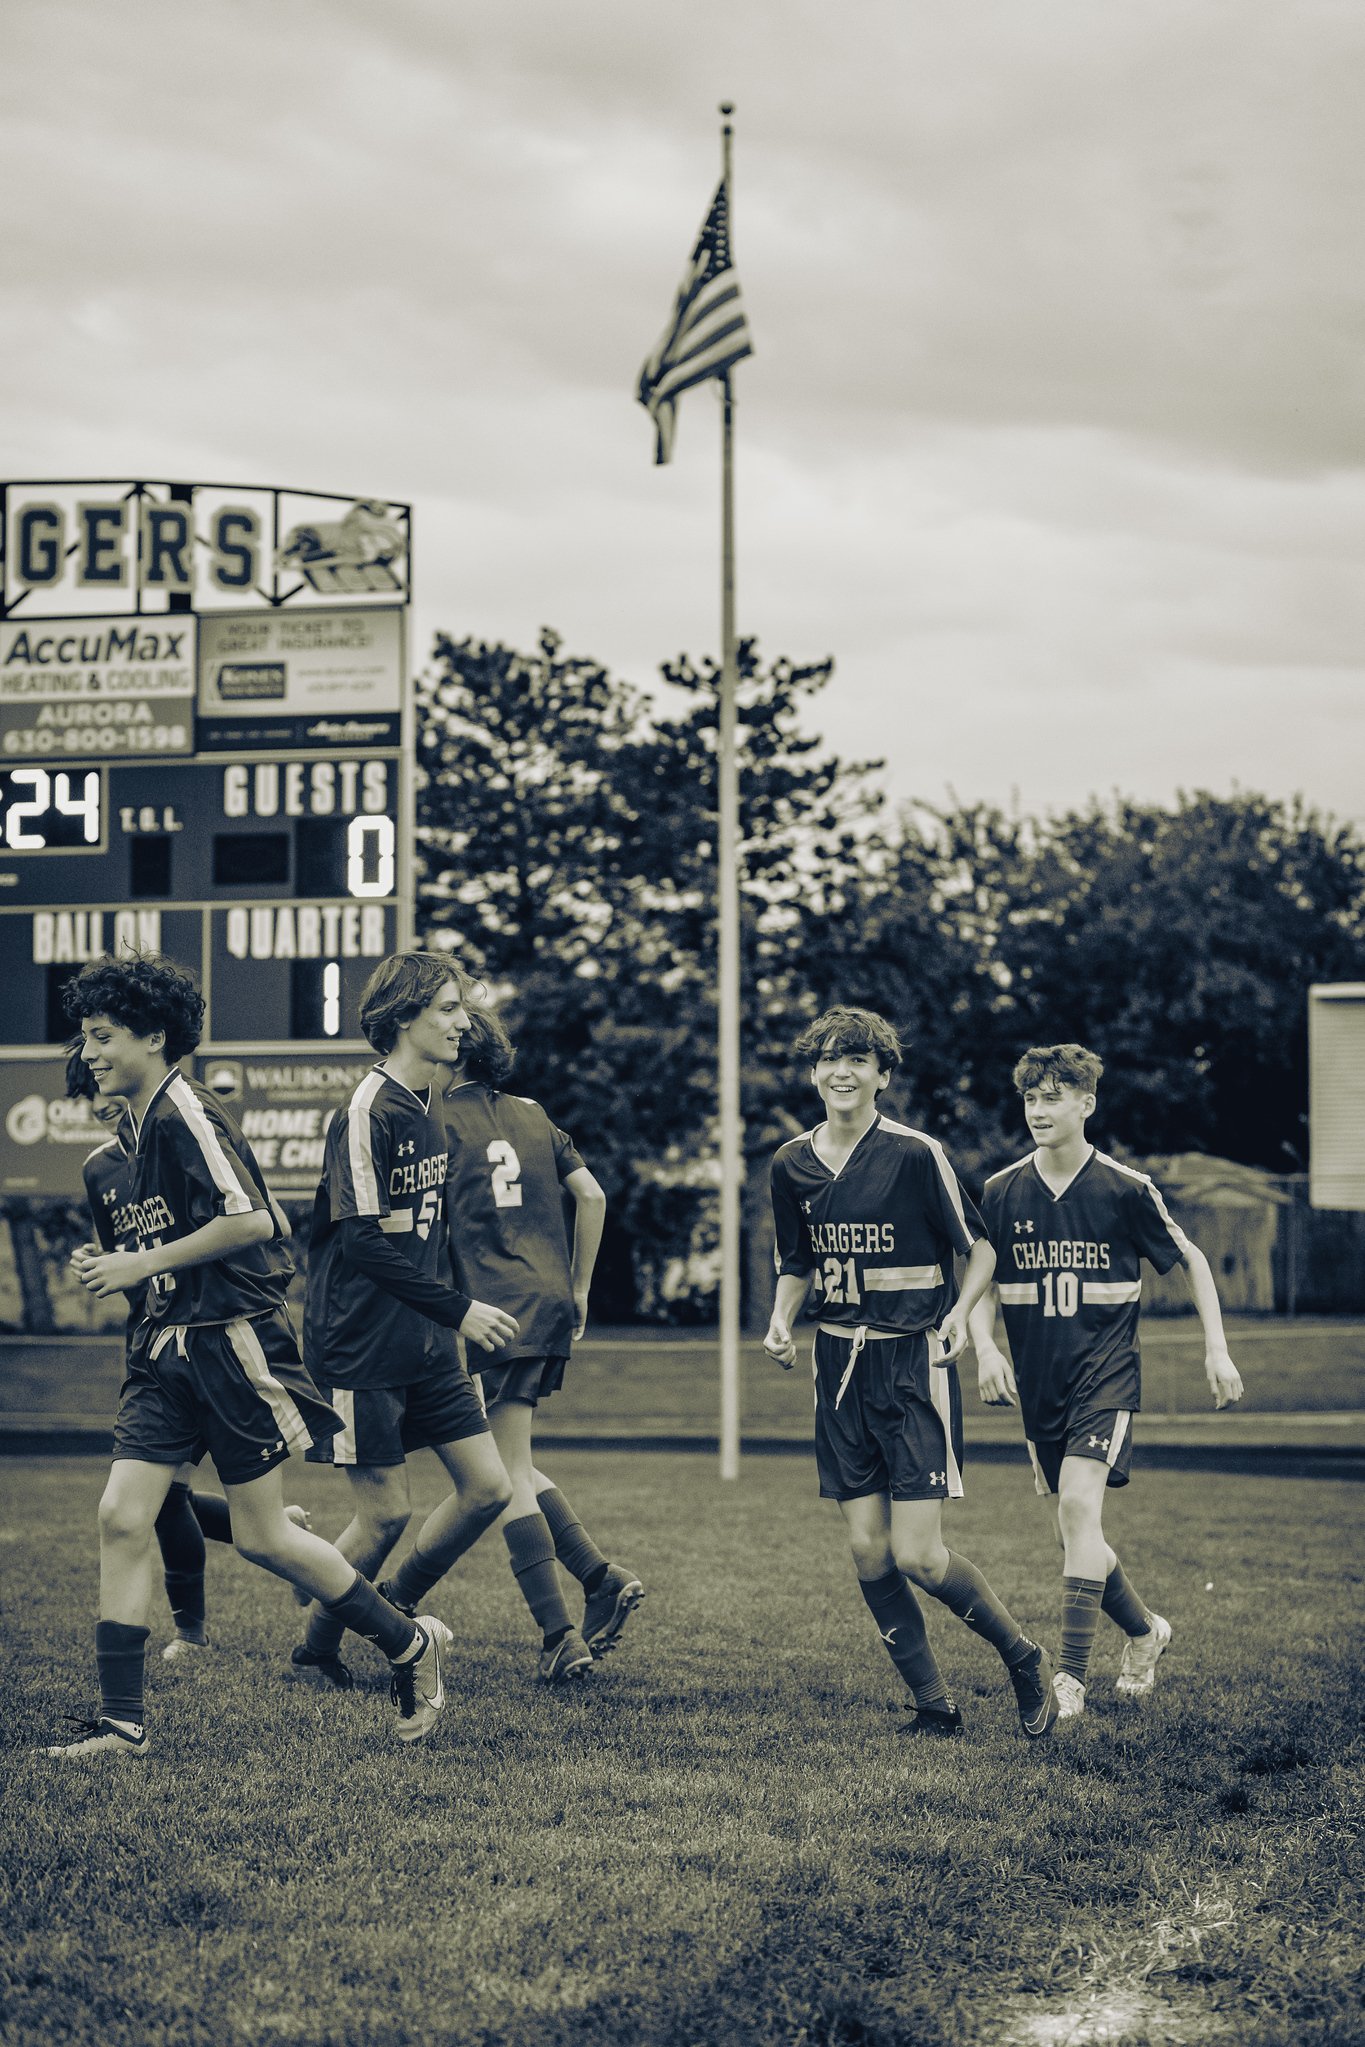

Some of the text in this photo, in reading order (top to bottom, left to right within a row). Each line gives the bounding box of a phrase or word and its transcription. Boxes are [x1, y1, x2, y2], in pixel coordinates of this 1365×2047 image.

[5, 628, 184, 666] AccuMax
[0, 668, 190, 693] HEATING & COOLING
[36, 702, 155, 729] AURORA
[224, 761, 388, 817] GUESTS
[348, 814, 395, 897] 0
[33, 909, 162, 965] BALL ON
[227, 905, 385, 959] QUARTER
[323, 962, 340, 1036] 1
[241, 1108, 322, 1139] HOME
[486, 1139, 523, 1208] 2
[416, 1190, 438, 1241] 5
[1012, 1240, 1111, 1270] CHARGERS
[823, 1257, 861, 1306] 21
[1042, 1272, 1079, 1317] 10
